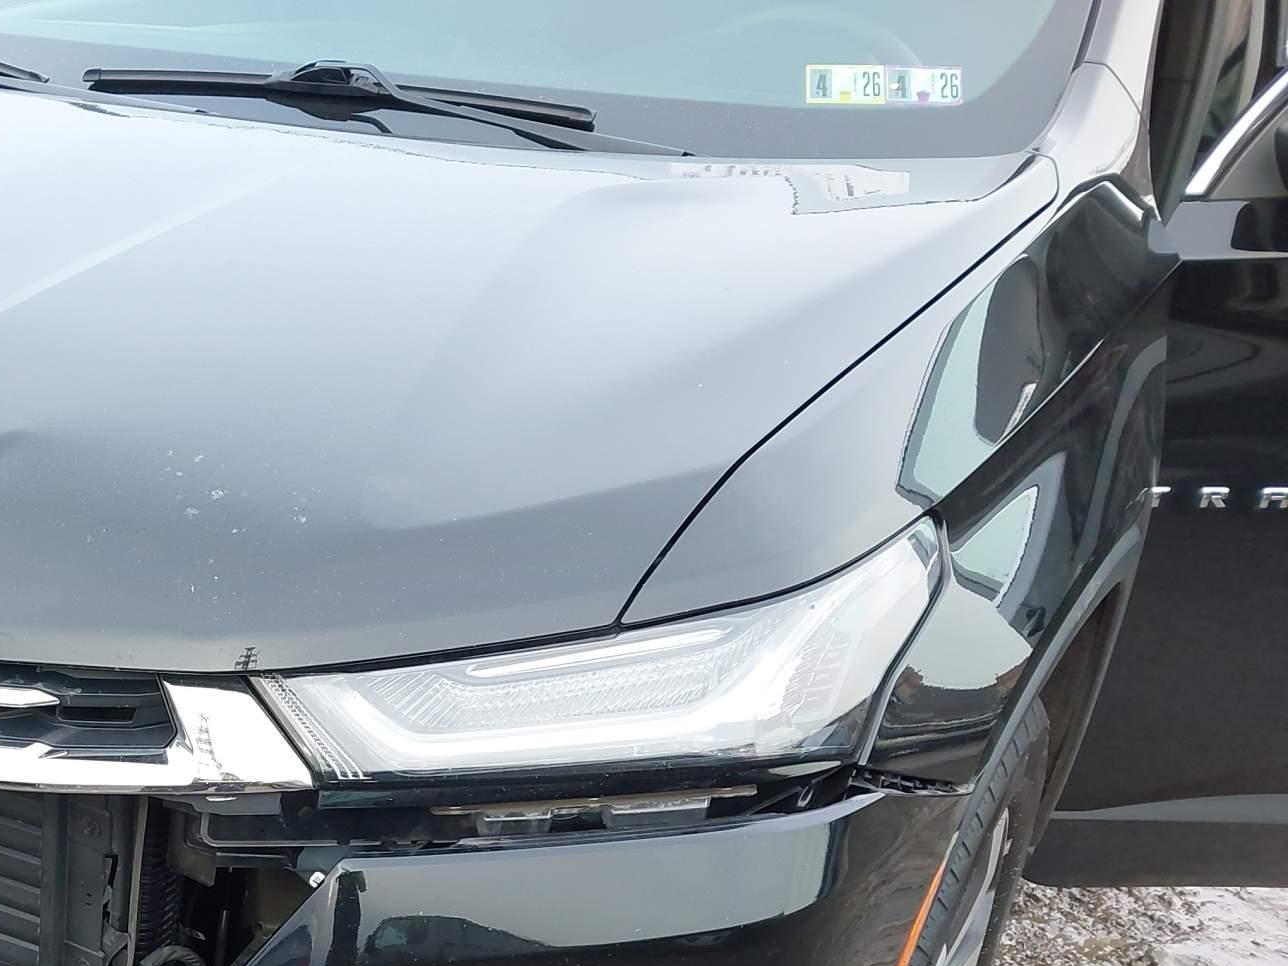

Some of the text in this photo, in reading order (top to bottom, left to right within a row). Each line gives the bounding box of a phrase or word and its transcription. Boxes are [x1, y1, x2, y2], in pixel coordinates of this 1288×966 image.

[815, 73, 828, 97] 4
[862, 71, 881, 97] 26
[940, 72, 959, 99] 26
